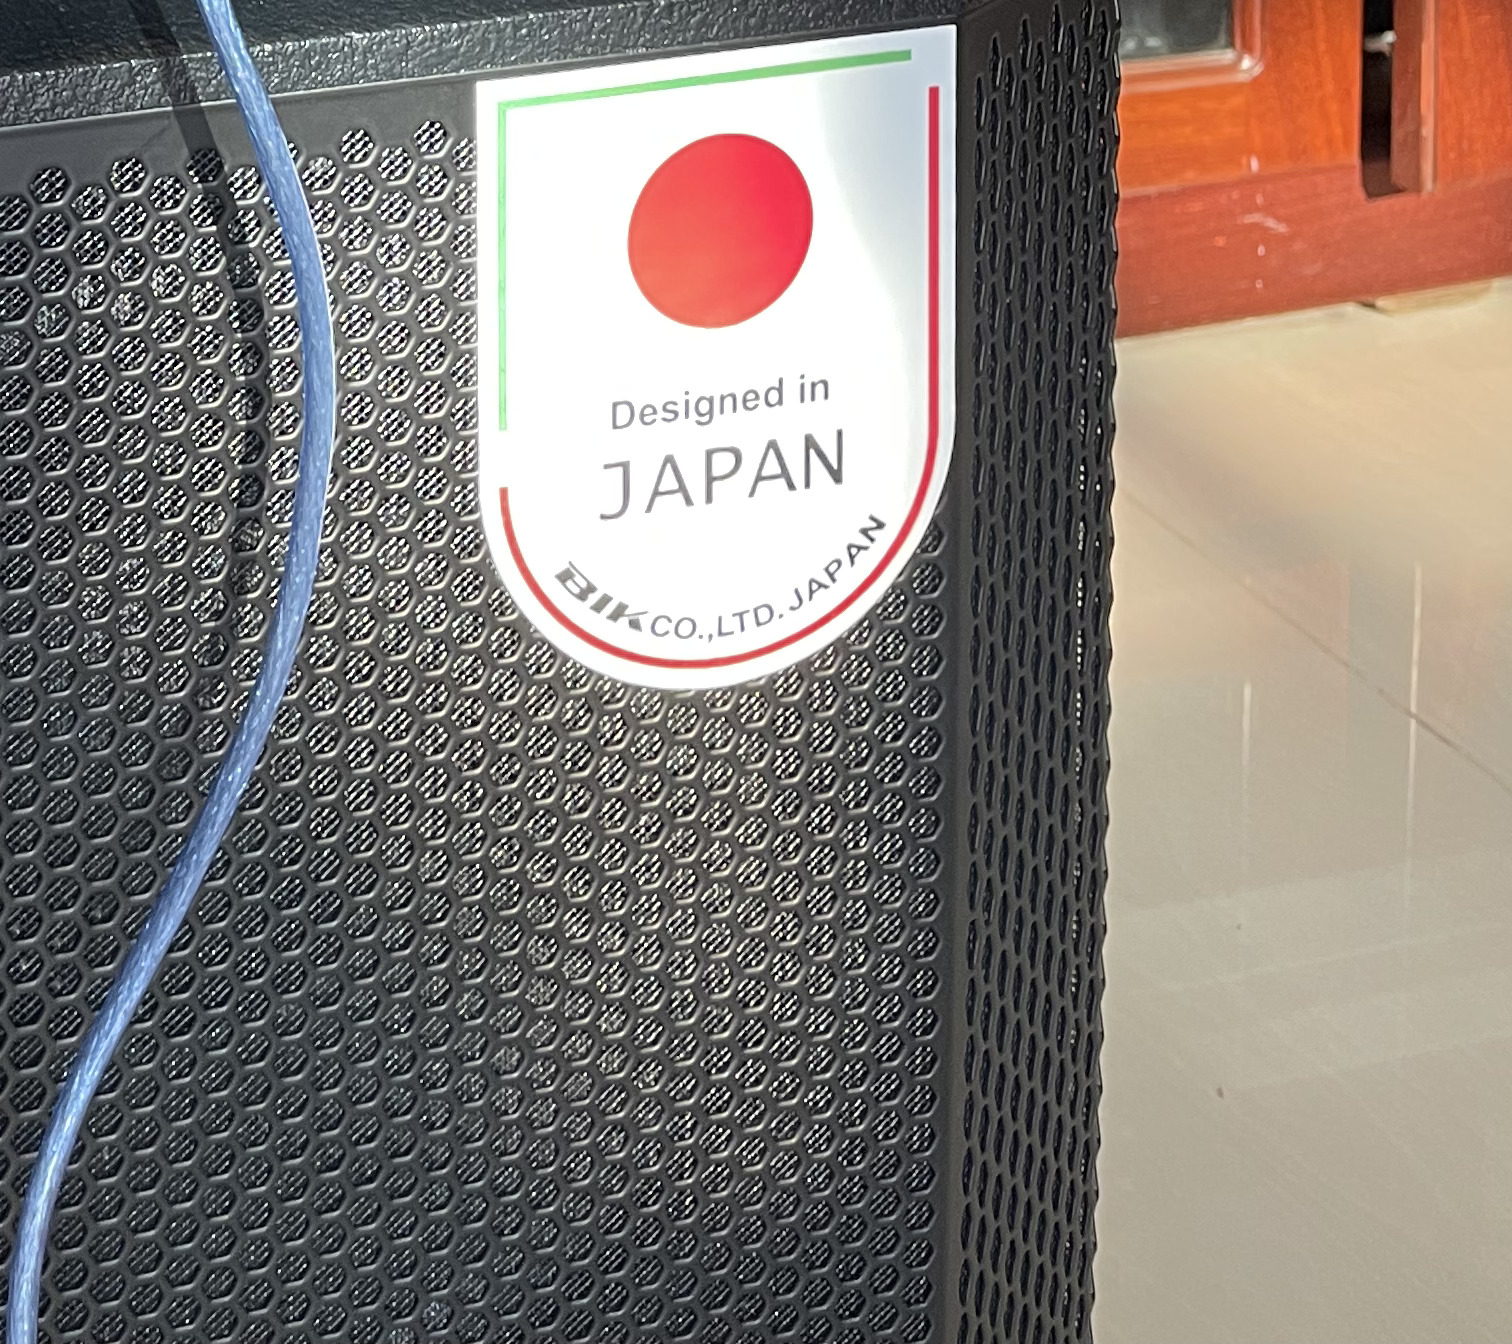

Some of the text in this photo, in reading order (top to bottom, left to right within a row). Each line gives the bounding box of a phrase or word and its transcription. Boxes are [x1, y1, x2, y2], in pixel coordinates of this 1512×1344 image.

[611, 374, 830, 430] Designed in
[599, 428, 844, 521] JAPAN
